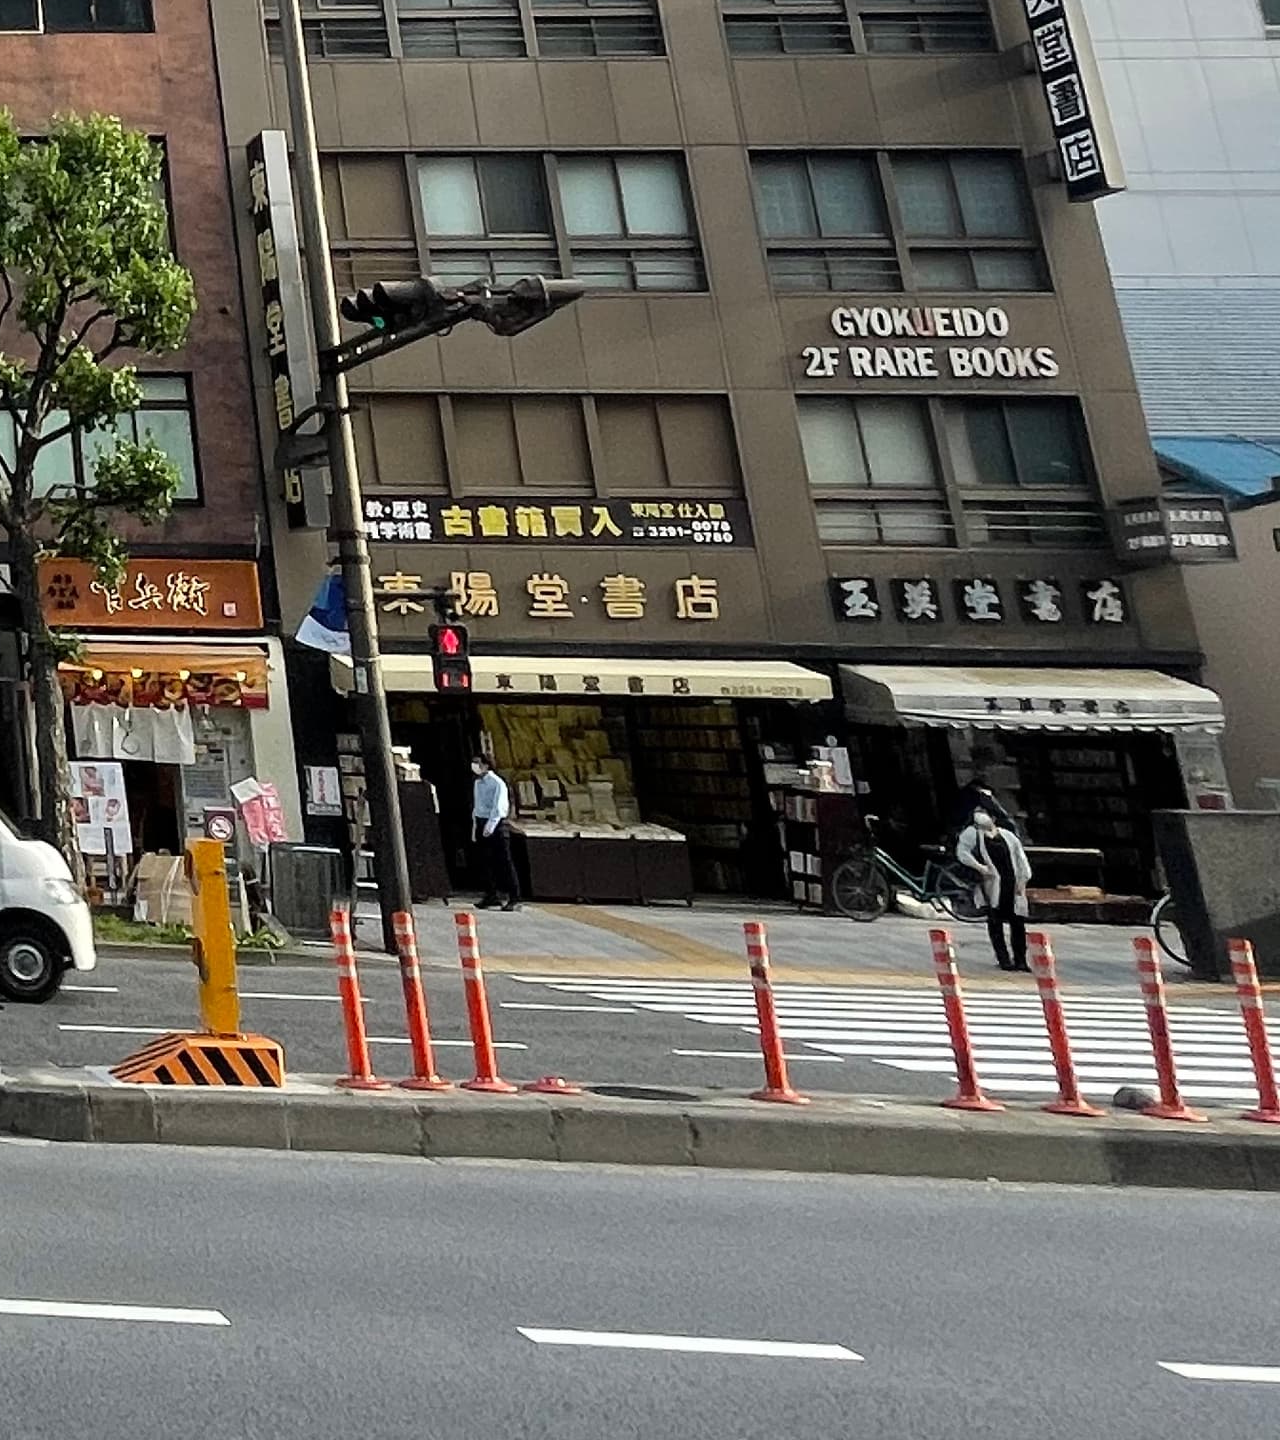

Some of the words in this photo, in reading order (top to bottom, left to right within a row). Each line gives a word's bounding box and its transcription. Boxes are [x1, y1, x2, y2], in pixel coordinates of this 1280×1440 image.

[831, 306, 1009, 338] GYOKUEIDO
[802, 346, 839, 378] 2F
[848, 346, 939, 378] RARE
[950, 346, 1061, 379] BOOKS
[440, 505, 624, 539] 古書籍買入
[377, 570, 721, 620] 東陽堂書店
[840, 578, 1125, 624] 玉英堂書店
